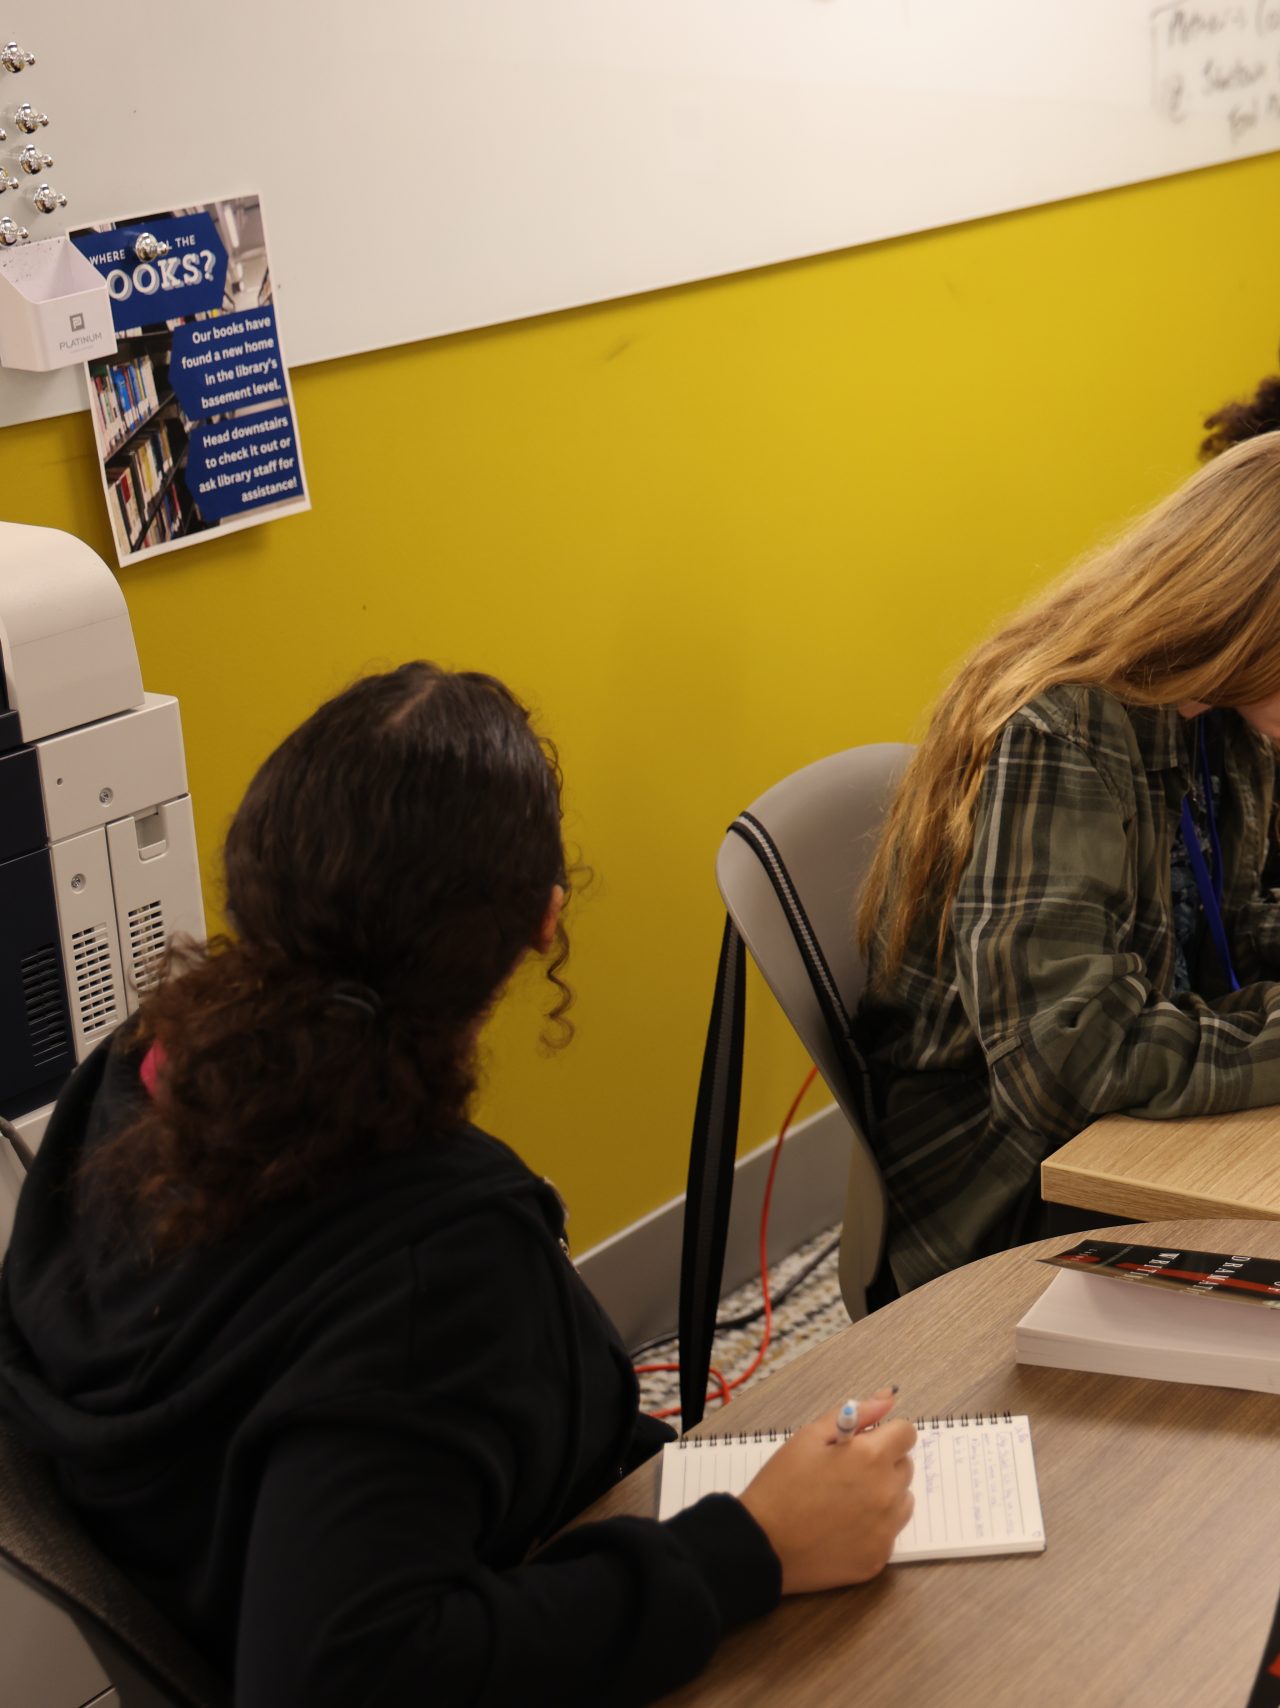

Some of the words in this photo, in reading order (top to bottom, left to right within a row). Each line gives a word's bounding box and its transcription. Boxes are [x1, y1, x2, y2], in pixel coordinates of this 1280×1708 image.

[89, 249, 126, 266] WHERE
[175, 235, 196, 249] THE
[106, 249, 216, 301] OOKS?
[59, 331, 103, 350] PLATINUM
[192, 331, 212, 344] Our
[212, 322, 244, 340] books
[245, 317, 271, 331] have
[181, 350, 212, 369] found
[214, 351, 221, 361] a
[222, 345, 243, 359] new
[244, 338, 274, 353] home
[204, 373, 215, 386] in
[216, 369, 234, 383] the
[201, 386, 252, 409] basement
[252, 378, 282, 396] level.
[202, 429, 230, 448] Head
[231, 416, 288, 440] downstairs
[205, 458, 217, 470] to
[218, 446, 249, 466] check
[250, 444, 259, 457] it
[260, 440, 278, 454] out
[279, 437, 291, 449] or
[199, 478, 217, 493] ask
[217, 468, 251, 488] library
[253, 459, 277, 478] staff
[278, 457, 294, 471] for
[241, 476, 298, 503] assistance!
